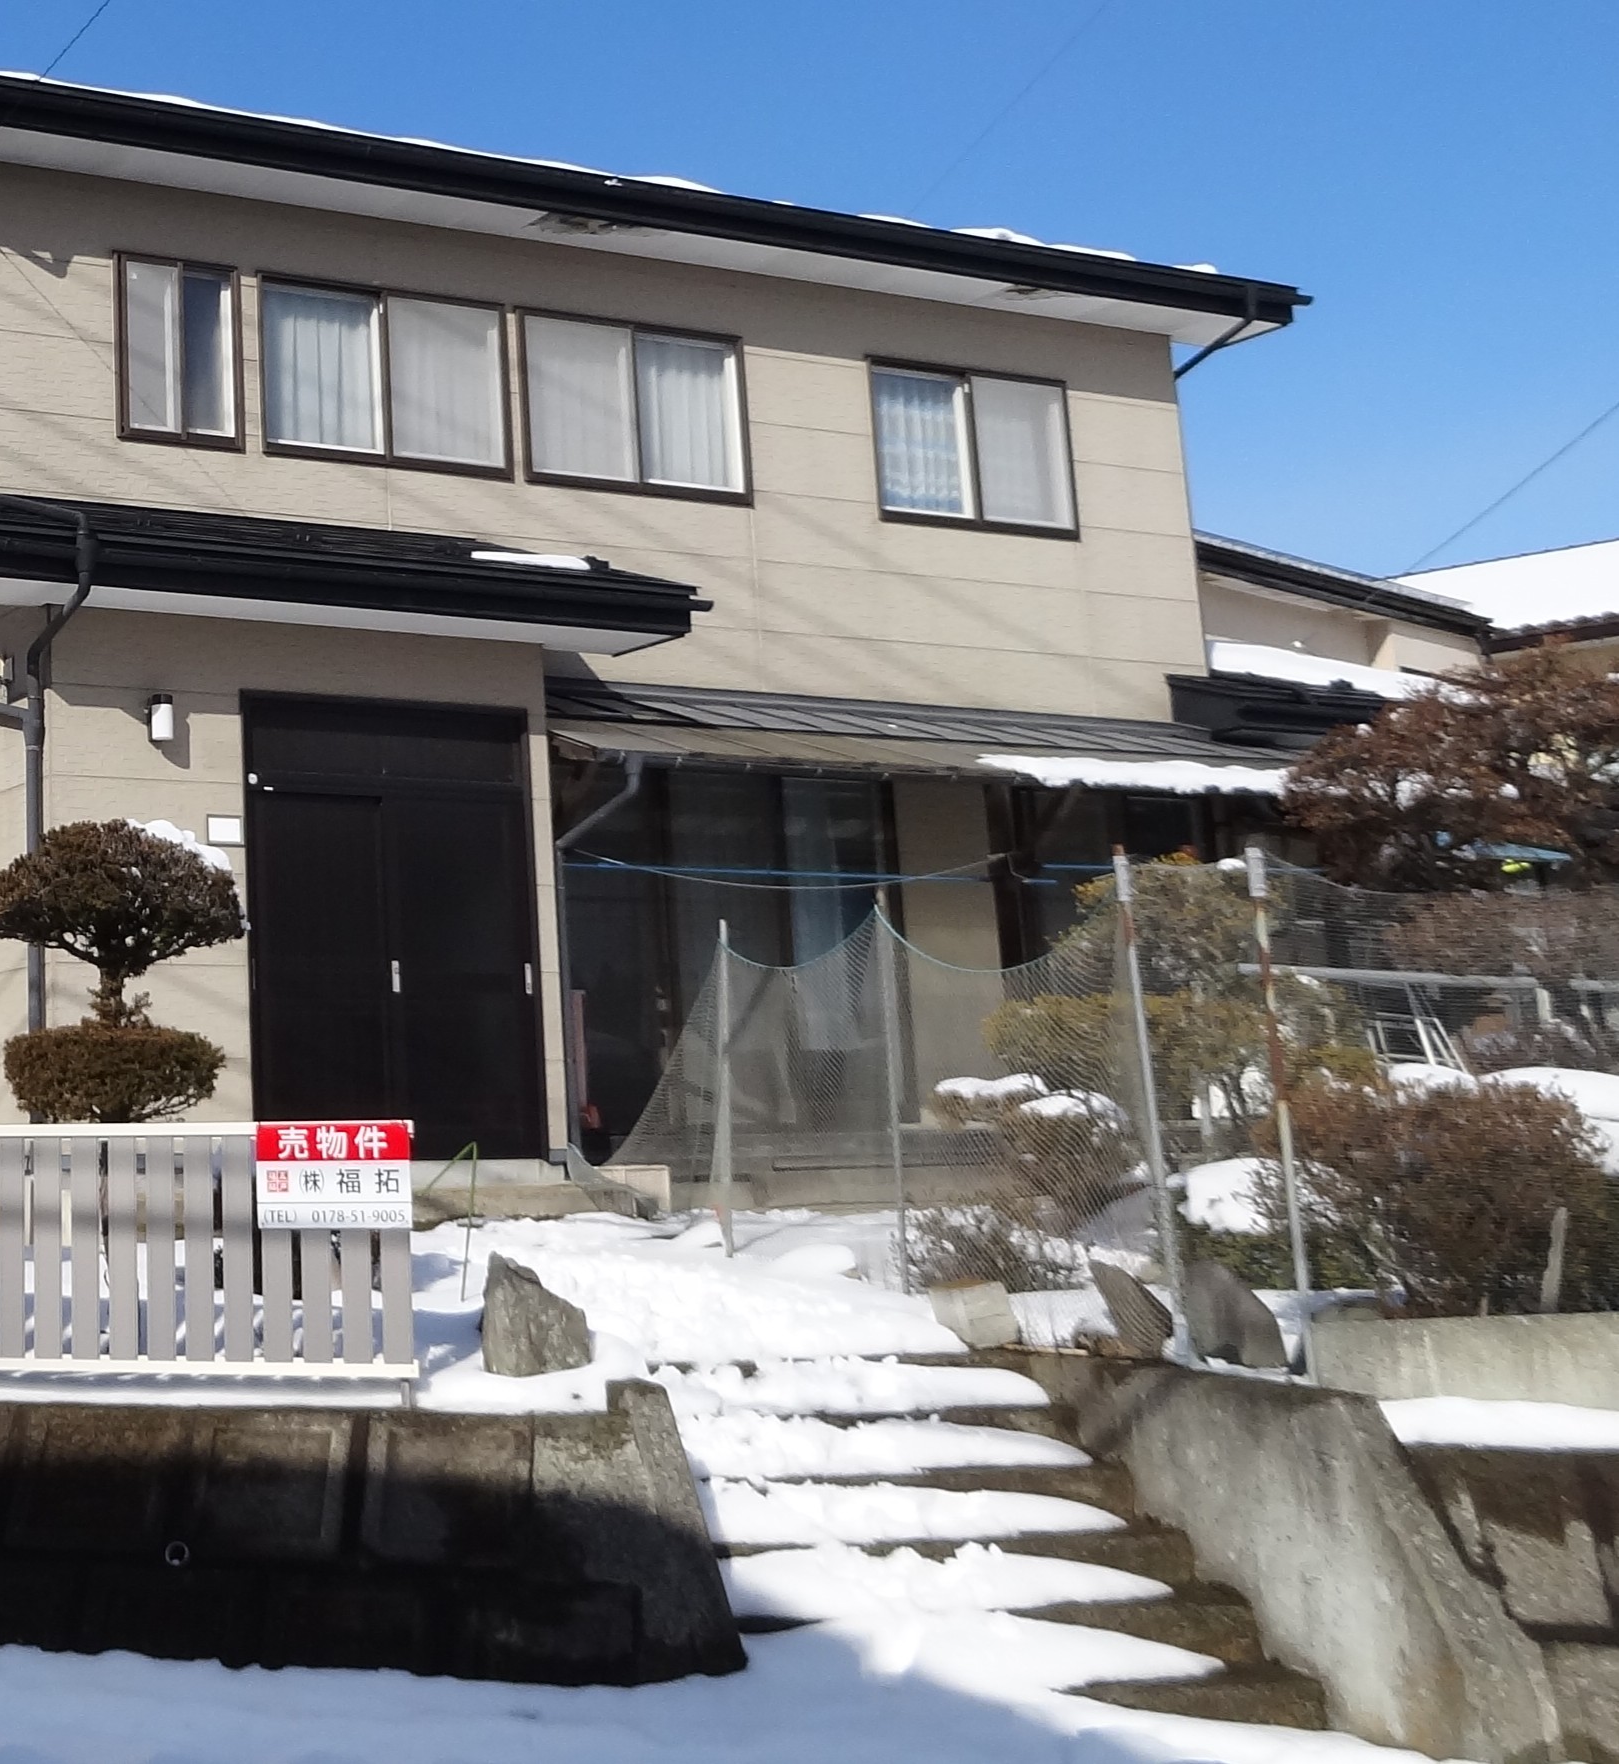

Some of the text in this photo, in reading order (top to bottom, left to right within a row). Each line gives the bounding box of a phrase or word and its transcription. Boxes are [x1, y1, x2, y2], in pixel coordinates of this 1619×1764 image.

[277, 1125, 388, 1160] 売物件
[263, 1208, 406, 1224] (TEL) 0178-51-9005
